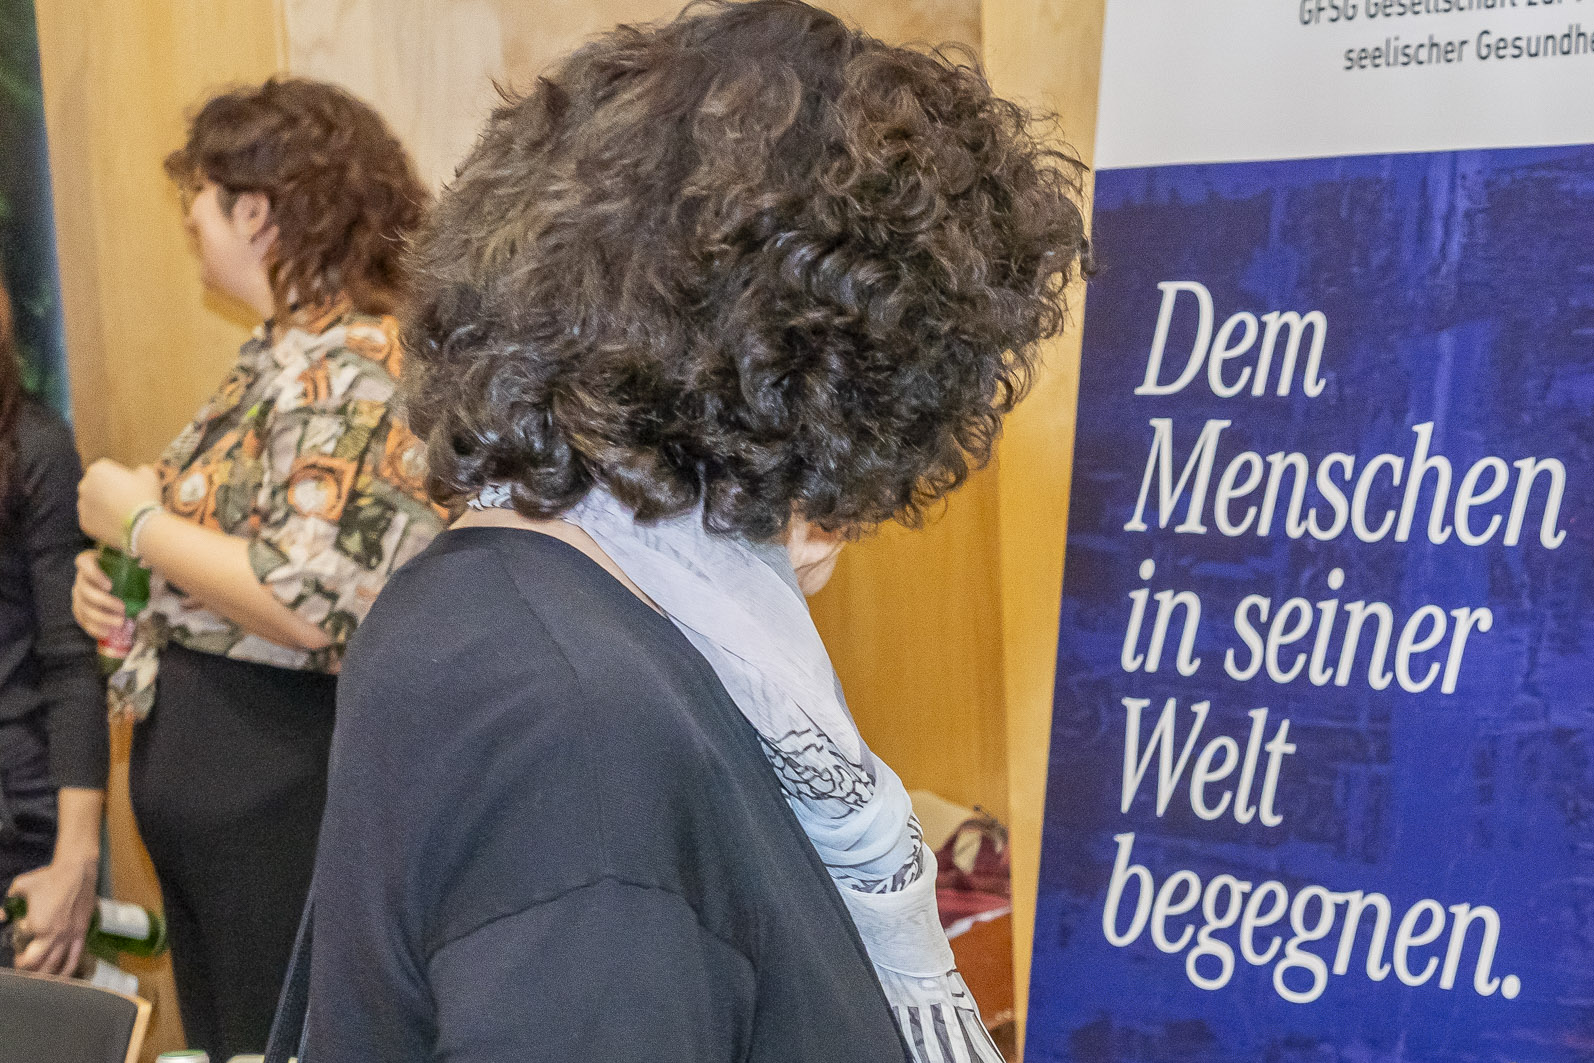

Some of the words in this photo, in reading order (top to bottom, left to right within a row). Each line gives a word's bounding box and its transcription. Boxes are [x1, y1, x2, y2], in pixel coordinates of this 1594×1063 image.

[1343, 34, 1469, 71] seelischer
[1135, 281, 1328, 399] Dem
[1124, 418, 1567, 550] Menschen
[1121, 559, 1201, 676] in
[1226, 567, 1493, 694] seiner
[1121, 697, 1296, 827] Welt
[1101, 832, 1522, 1004] begegnen.
